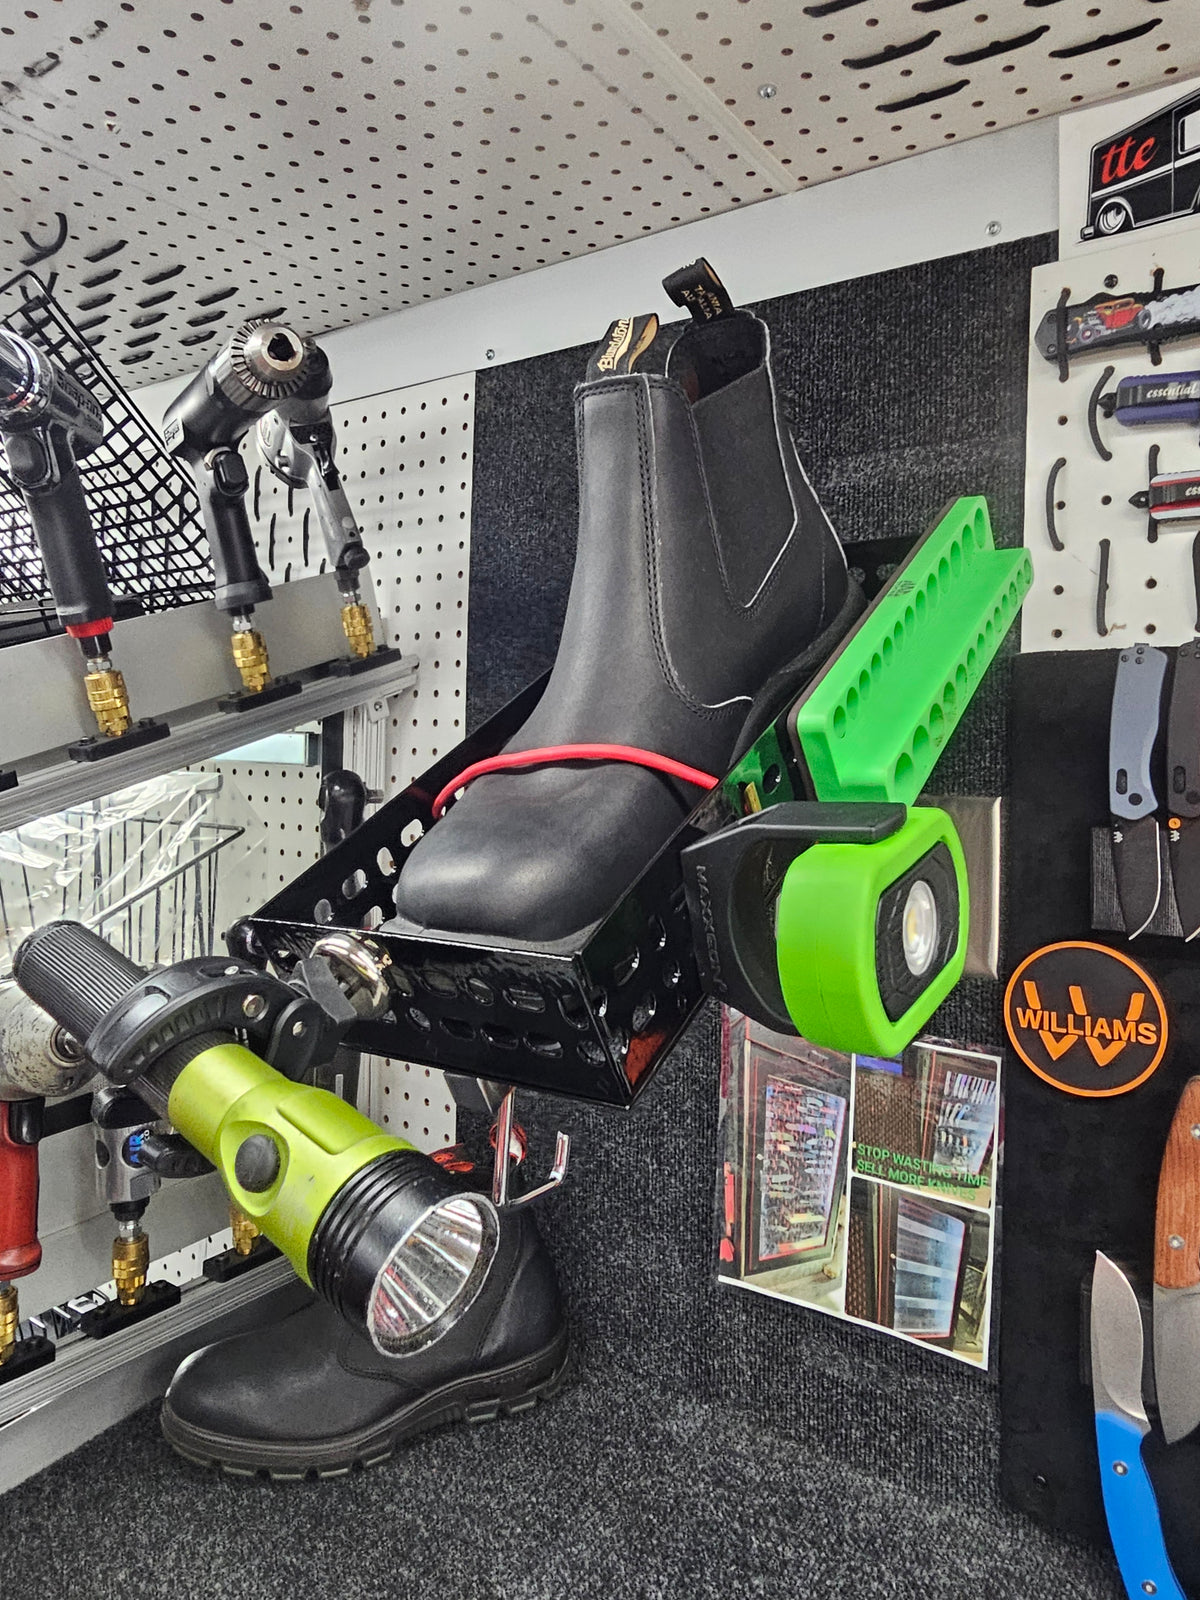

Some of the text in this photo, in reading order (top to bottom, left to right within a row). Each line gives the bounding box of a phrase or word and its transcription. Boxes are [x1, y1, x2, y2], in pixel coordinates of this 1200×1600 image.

[1101, 136, 1160, 184] tte
[1146, 382, 1200, 399] essential
[696, 865, 724, 985] MAXXEON
[1016, 1007, 1157, 1045] WILLIAMS
[857, 1143, 990, 1188] STOP WASTING TIME
[857, 1159, 977, 1201] SELL MORE KNIVES
